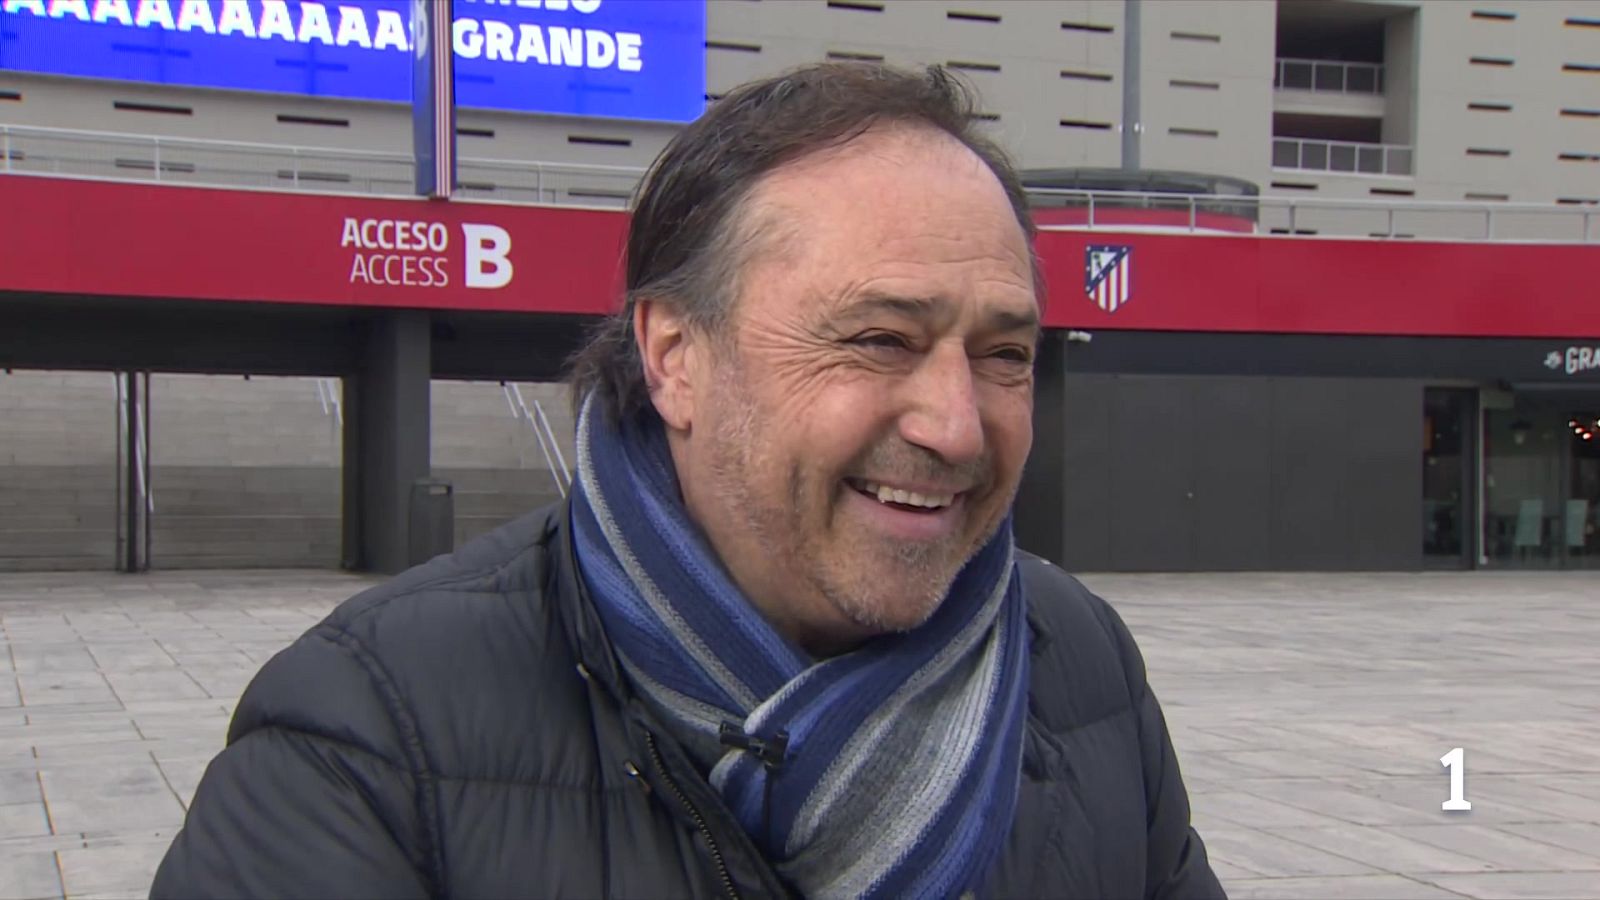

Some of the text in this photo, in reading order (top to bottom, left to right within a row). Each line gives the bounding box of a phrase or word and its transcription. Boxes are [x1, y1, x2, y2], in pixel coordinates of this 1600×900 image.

[452, 17, 643, 72] GRANDE
[341, 217, 449, 252] ACCESO
[461, 223, 513, 289] B
[350, 253, 449, 287] ACCESS
